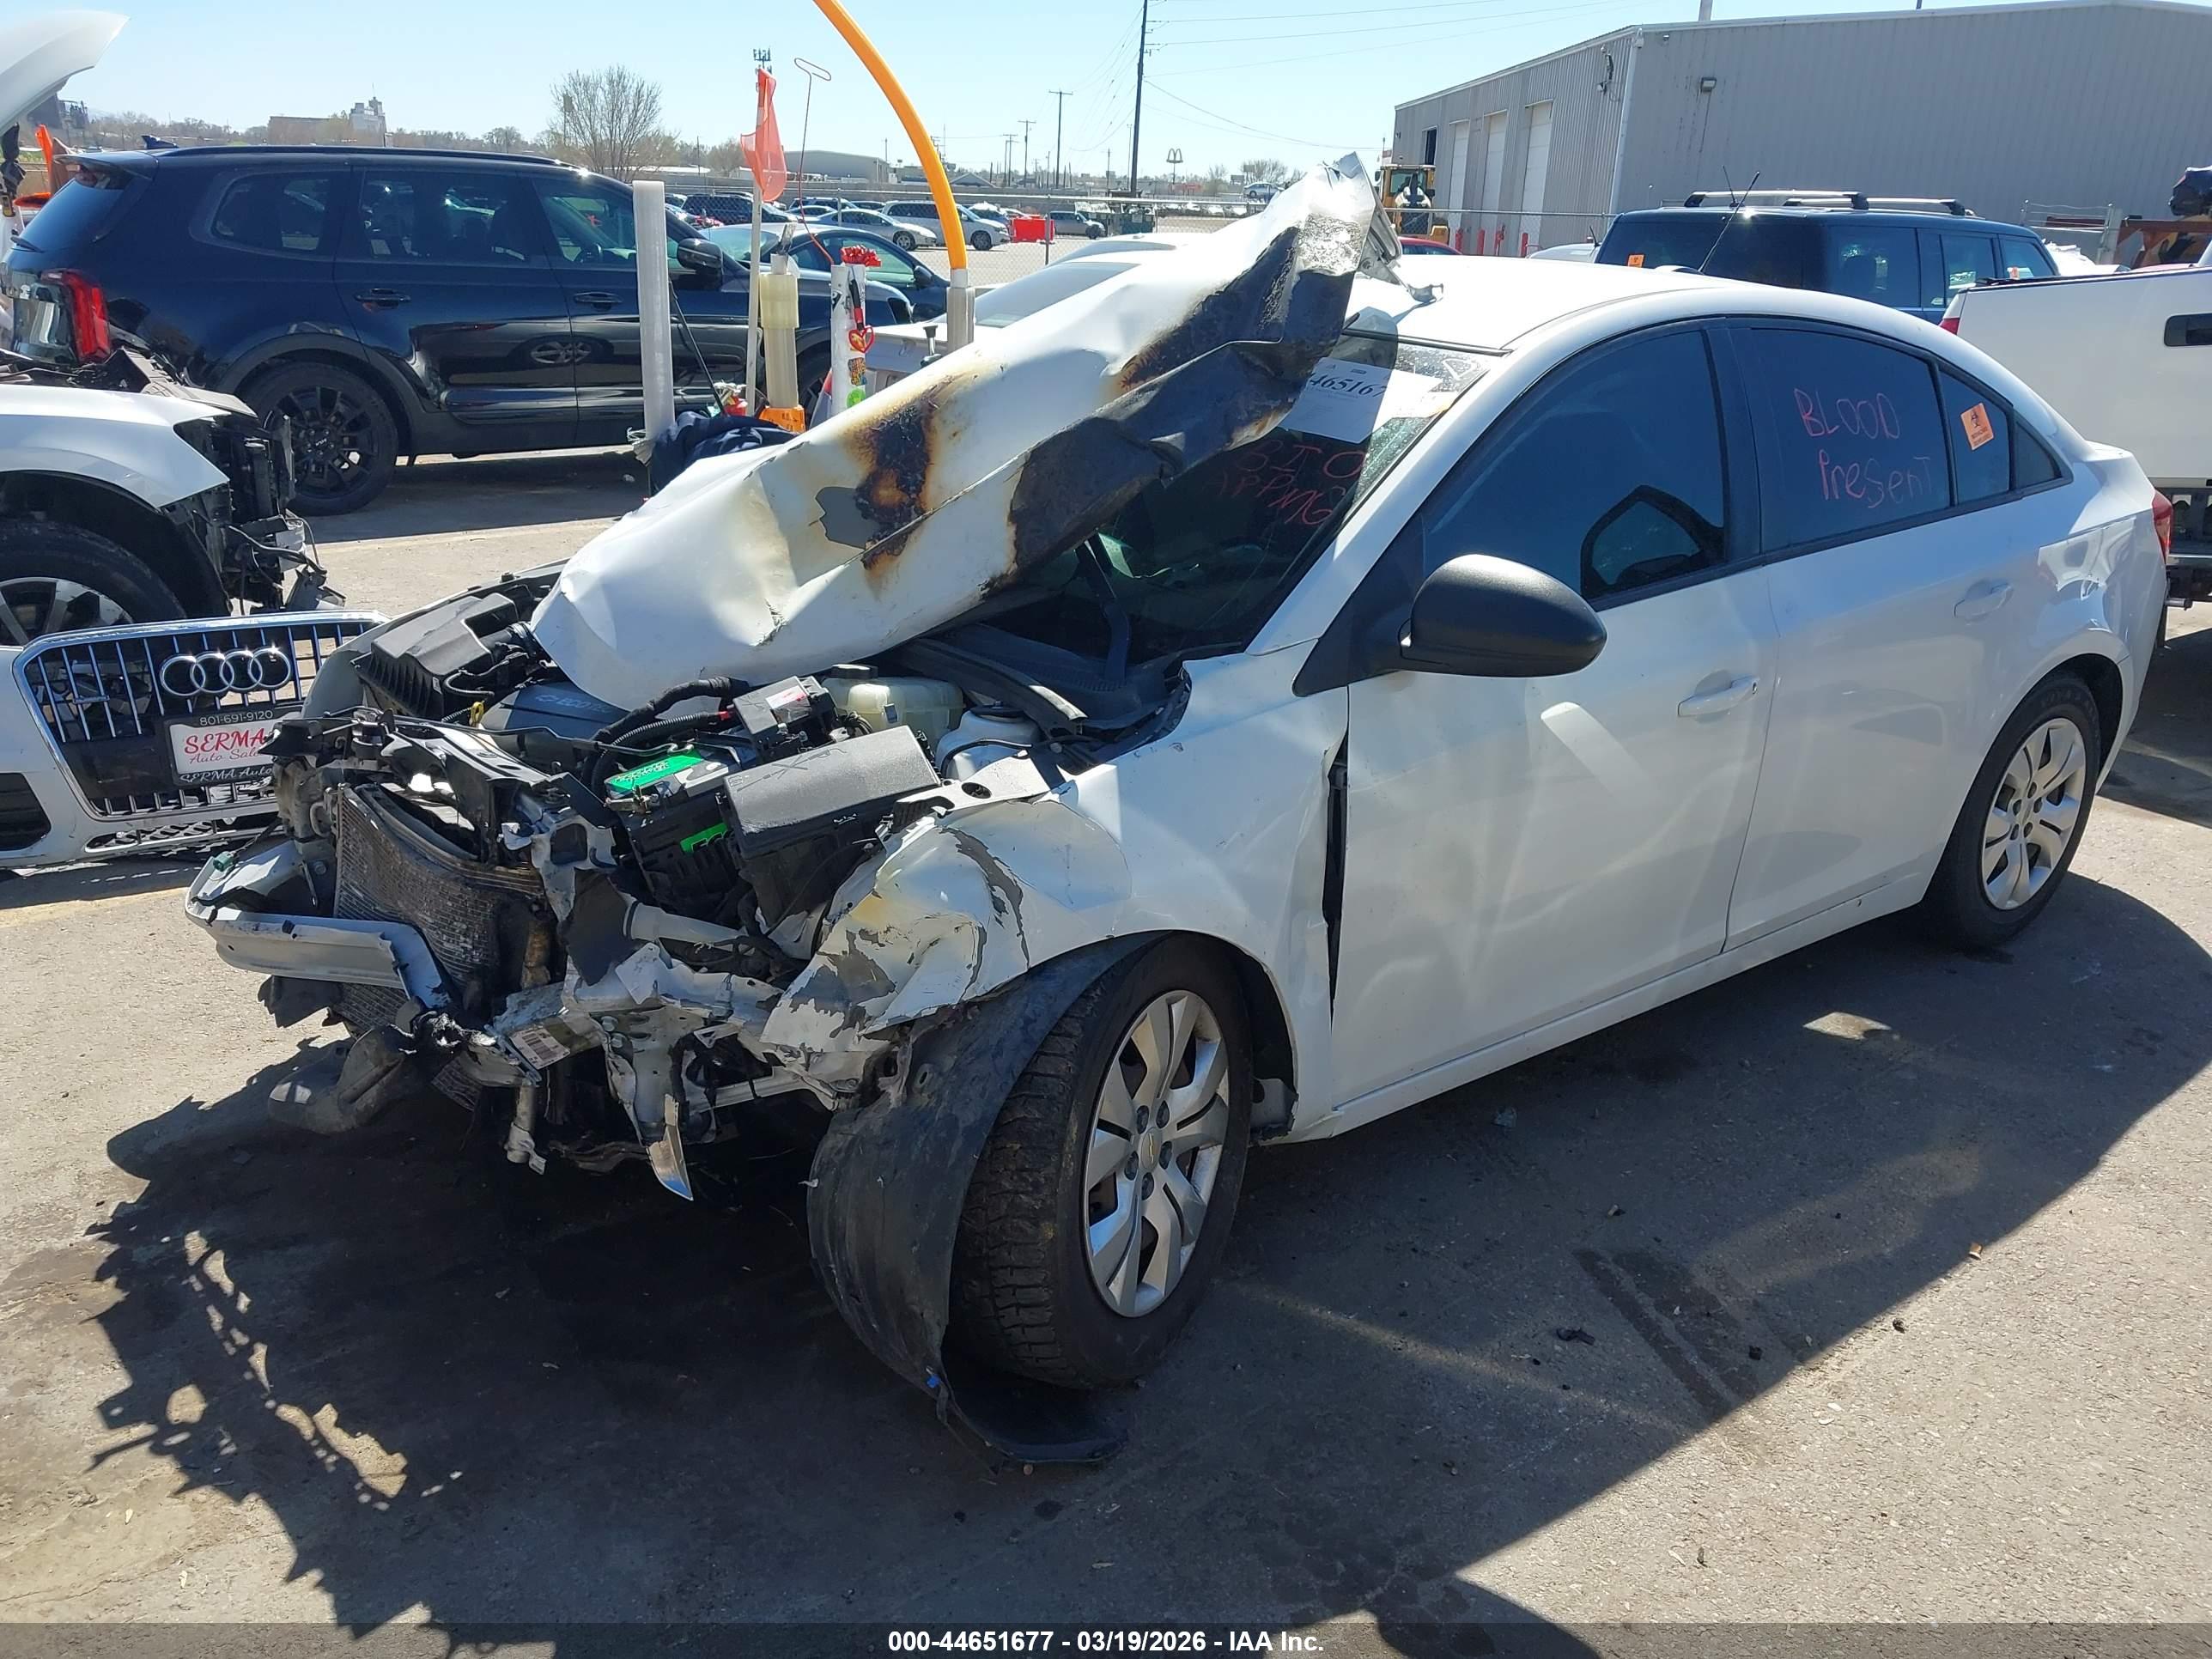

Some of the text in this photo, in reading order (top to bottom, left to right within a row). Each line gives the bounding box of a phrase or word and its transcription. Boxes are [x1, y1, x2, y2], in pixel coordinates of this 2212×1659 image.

[1794, 388, 1900, 439] BLOOD
[199, 710, 274, 726] 801-691-9120
[184, 727, 265, 754] SERMA
[189, 752, 223, 764] Auto
[180, 766, 273, 783] SERMA Auto
